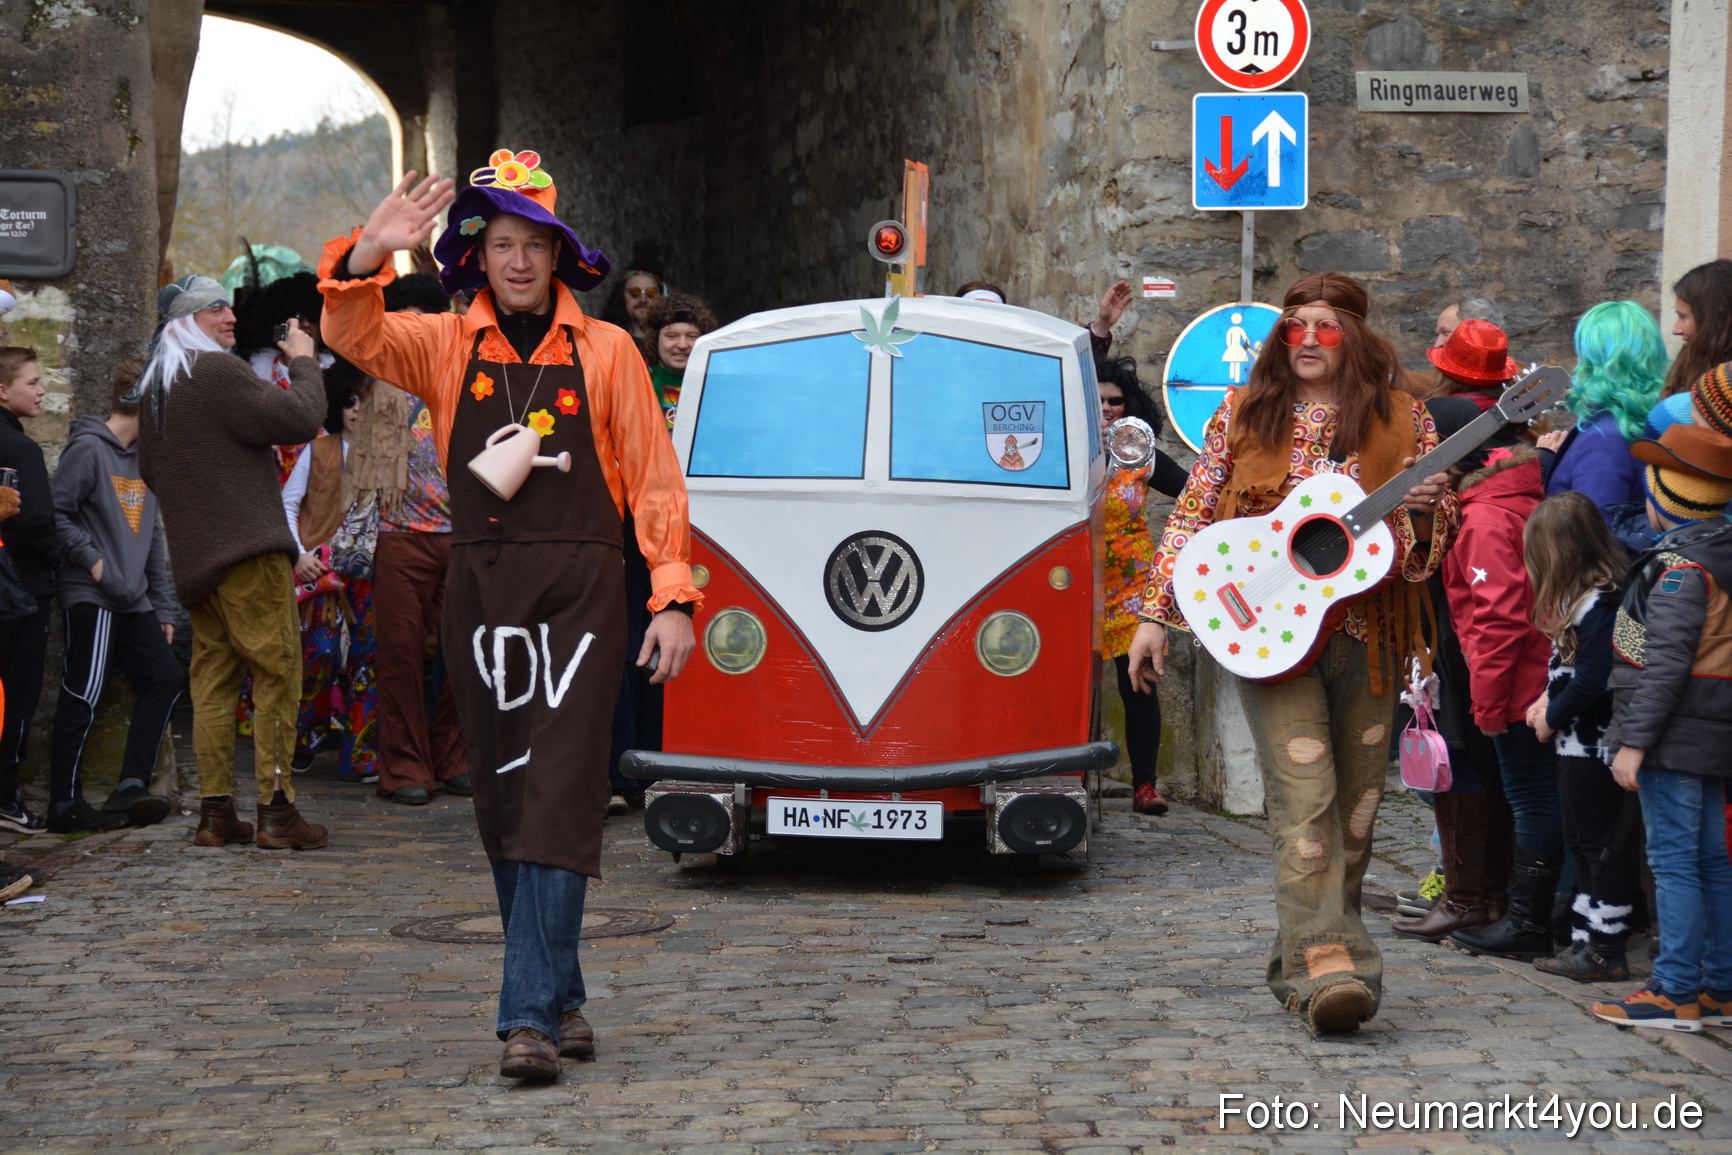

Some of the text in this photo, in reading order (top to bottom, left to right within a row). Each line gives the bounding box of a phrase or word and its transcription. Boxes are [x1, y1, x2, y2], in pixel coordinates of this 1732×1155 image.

[1227, 9, 1279, 56] 3 m
[1370, 78, 1519, 107] Ringmauerweg
[0, 208, 47, 220] Torturm
[991, 404, 1036, 421] OGV
[993, 423, 1035, 431] BERCHING
[830, 536, 918, 626] VW
[783, 806, 928, 830] HA NF 1973
